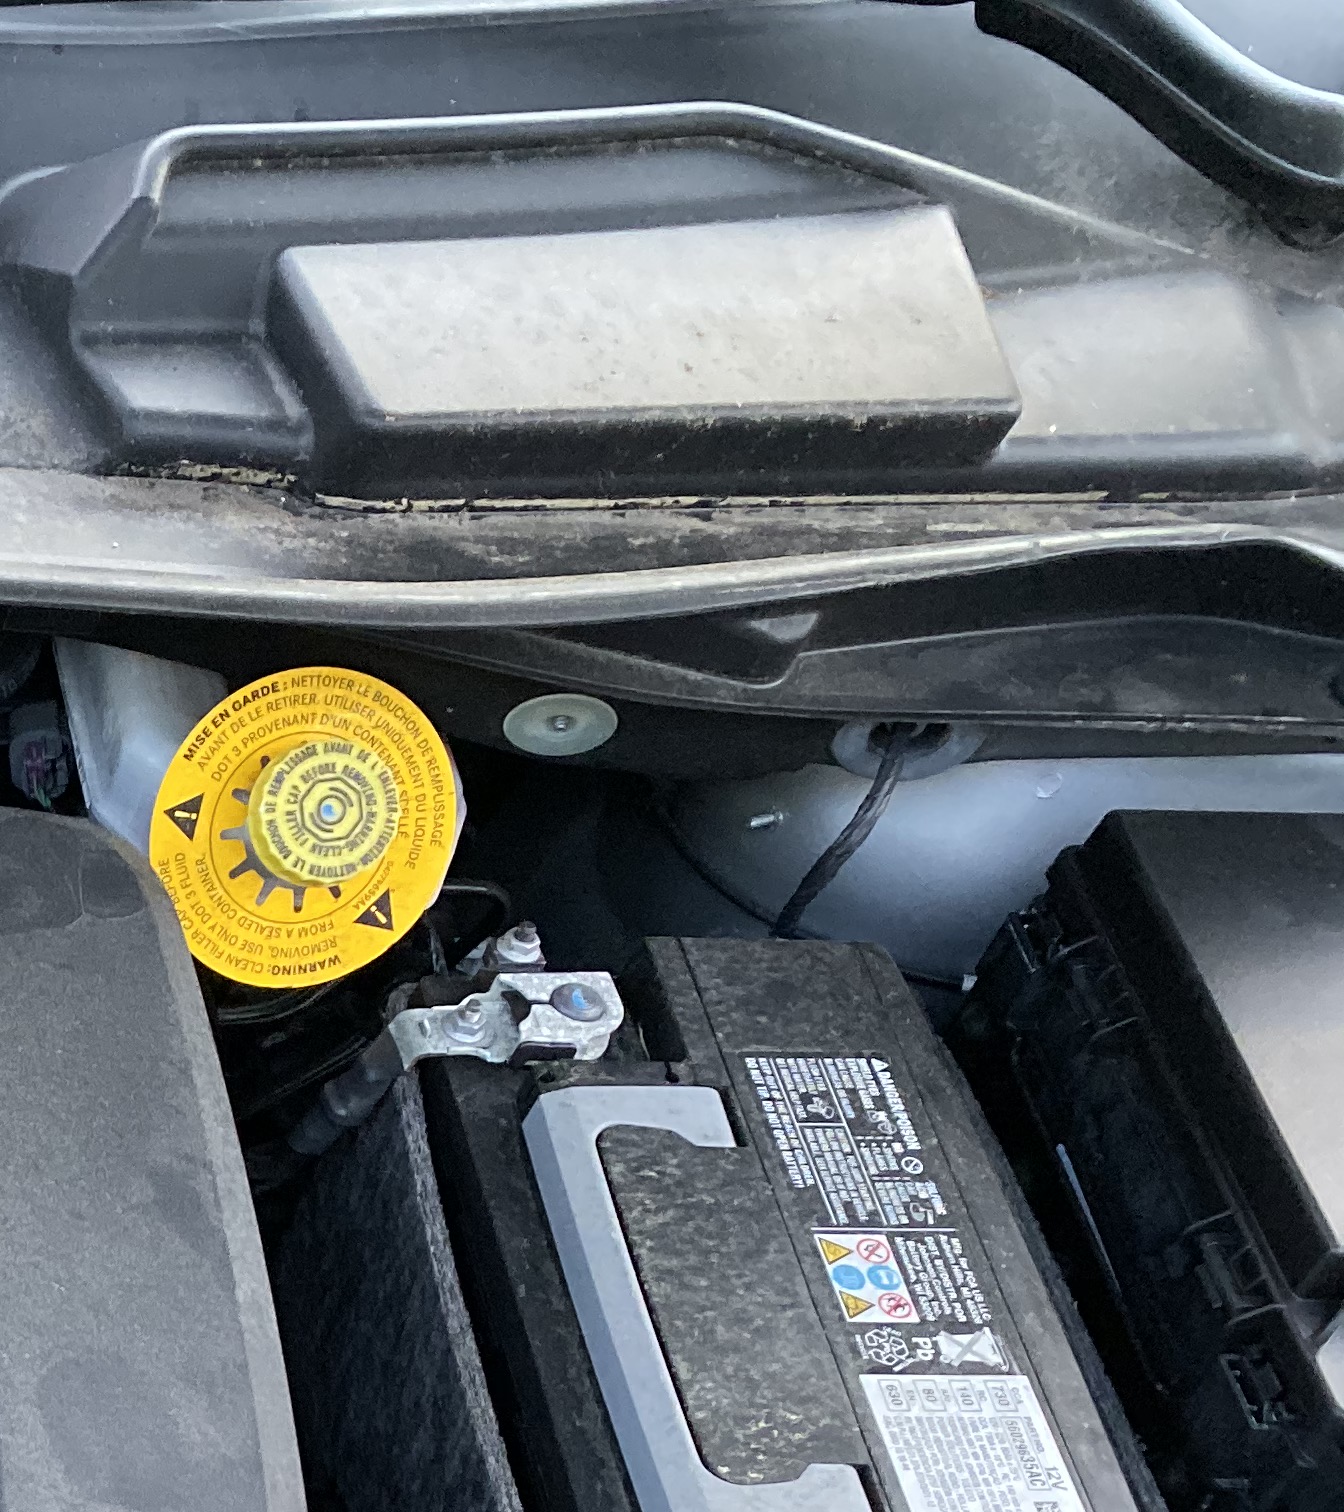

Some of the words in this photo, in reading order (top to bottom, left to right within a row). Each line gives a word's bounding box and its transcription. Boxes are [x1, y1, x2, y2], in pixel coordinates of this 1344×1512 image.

[248, 706, 264, 722] LE
[324, 694, 376, 722] UTILISER
[230, 716, 248, 734] DE
[198, 730, 229, 772] AVANT
[211, 754, 232, 782] DOT
[232, 746, 241, 756] 3
[241, 712, 317, 748] PROVENANT
[353, 725, 405, 786] CONTENANT
[372, 716, 424, 789] UNIQUEMENT
[183, 726, 212, 761] MISE
[211, 709, 231, 728] EN
[291, 674, 354, 691] NETTOYER
[357, 684, 372, 698] LE
[372, 690, 422, 739] BOUCHON
[417, 738, 433, 757] DE
[426, 755, 446, 848] REMPLISSAGE
[415, 793, 426, 812] DU
[404, 817, 427, 869] LIQUIDE
[175, 852, 192, 889] FLUID
[185, 890, 196, 899] 3
[176, 909, 193, 929] CAP
[191, 901, 211, 924] DOT
[208, 922, 238, 946] ONLY
[238, 916, 281, 939] SEALED
[286, 928, 293, 938] A
[298, 920, 333, 938] FROM
[191, 928, 224, 959] FILLER
[239, 940, 263, 955] USE
[225, 953, 263, 973] CLEAN
[912, 1337, 935, 1360] Pb
[886, 1385, 903, 1406] 630
[922, 1388, 936, 1403] 80
[957, 1387, 974, 1406] 140
[991, 1386, 1010, 1407] 730
[1045, 1465, 1067, 1490] 12V
